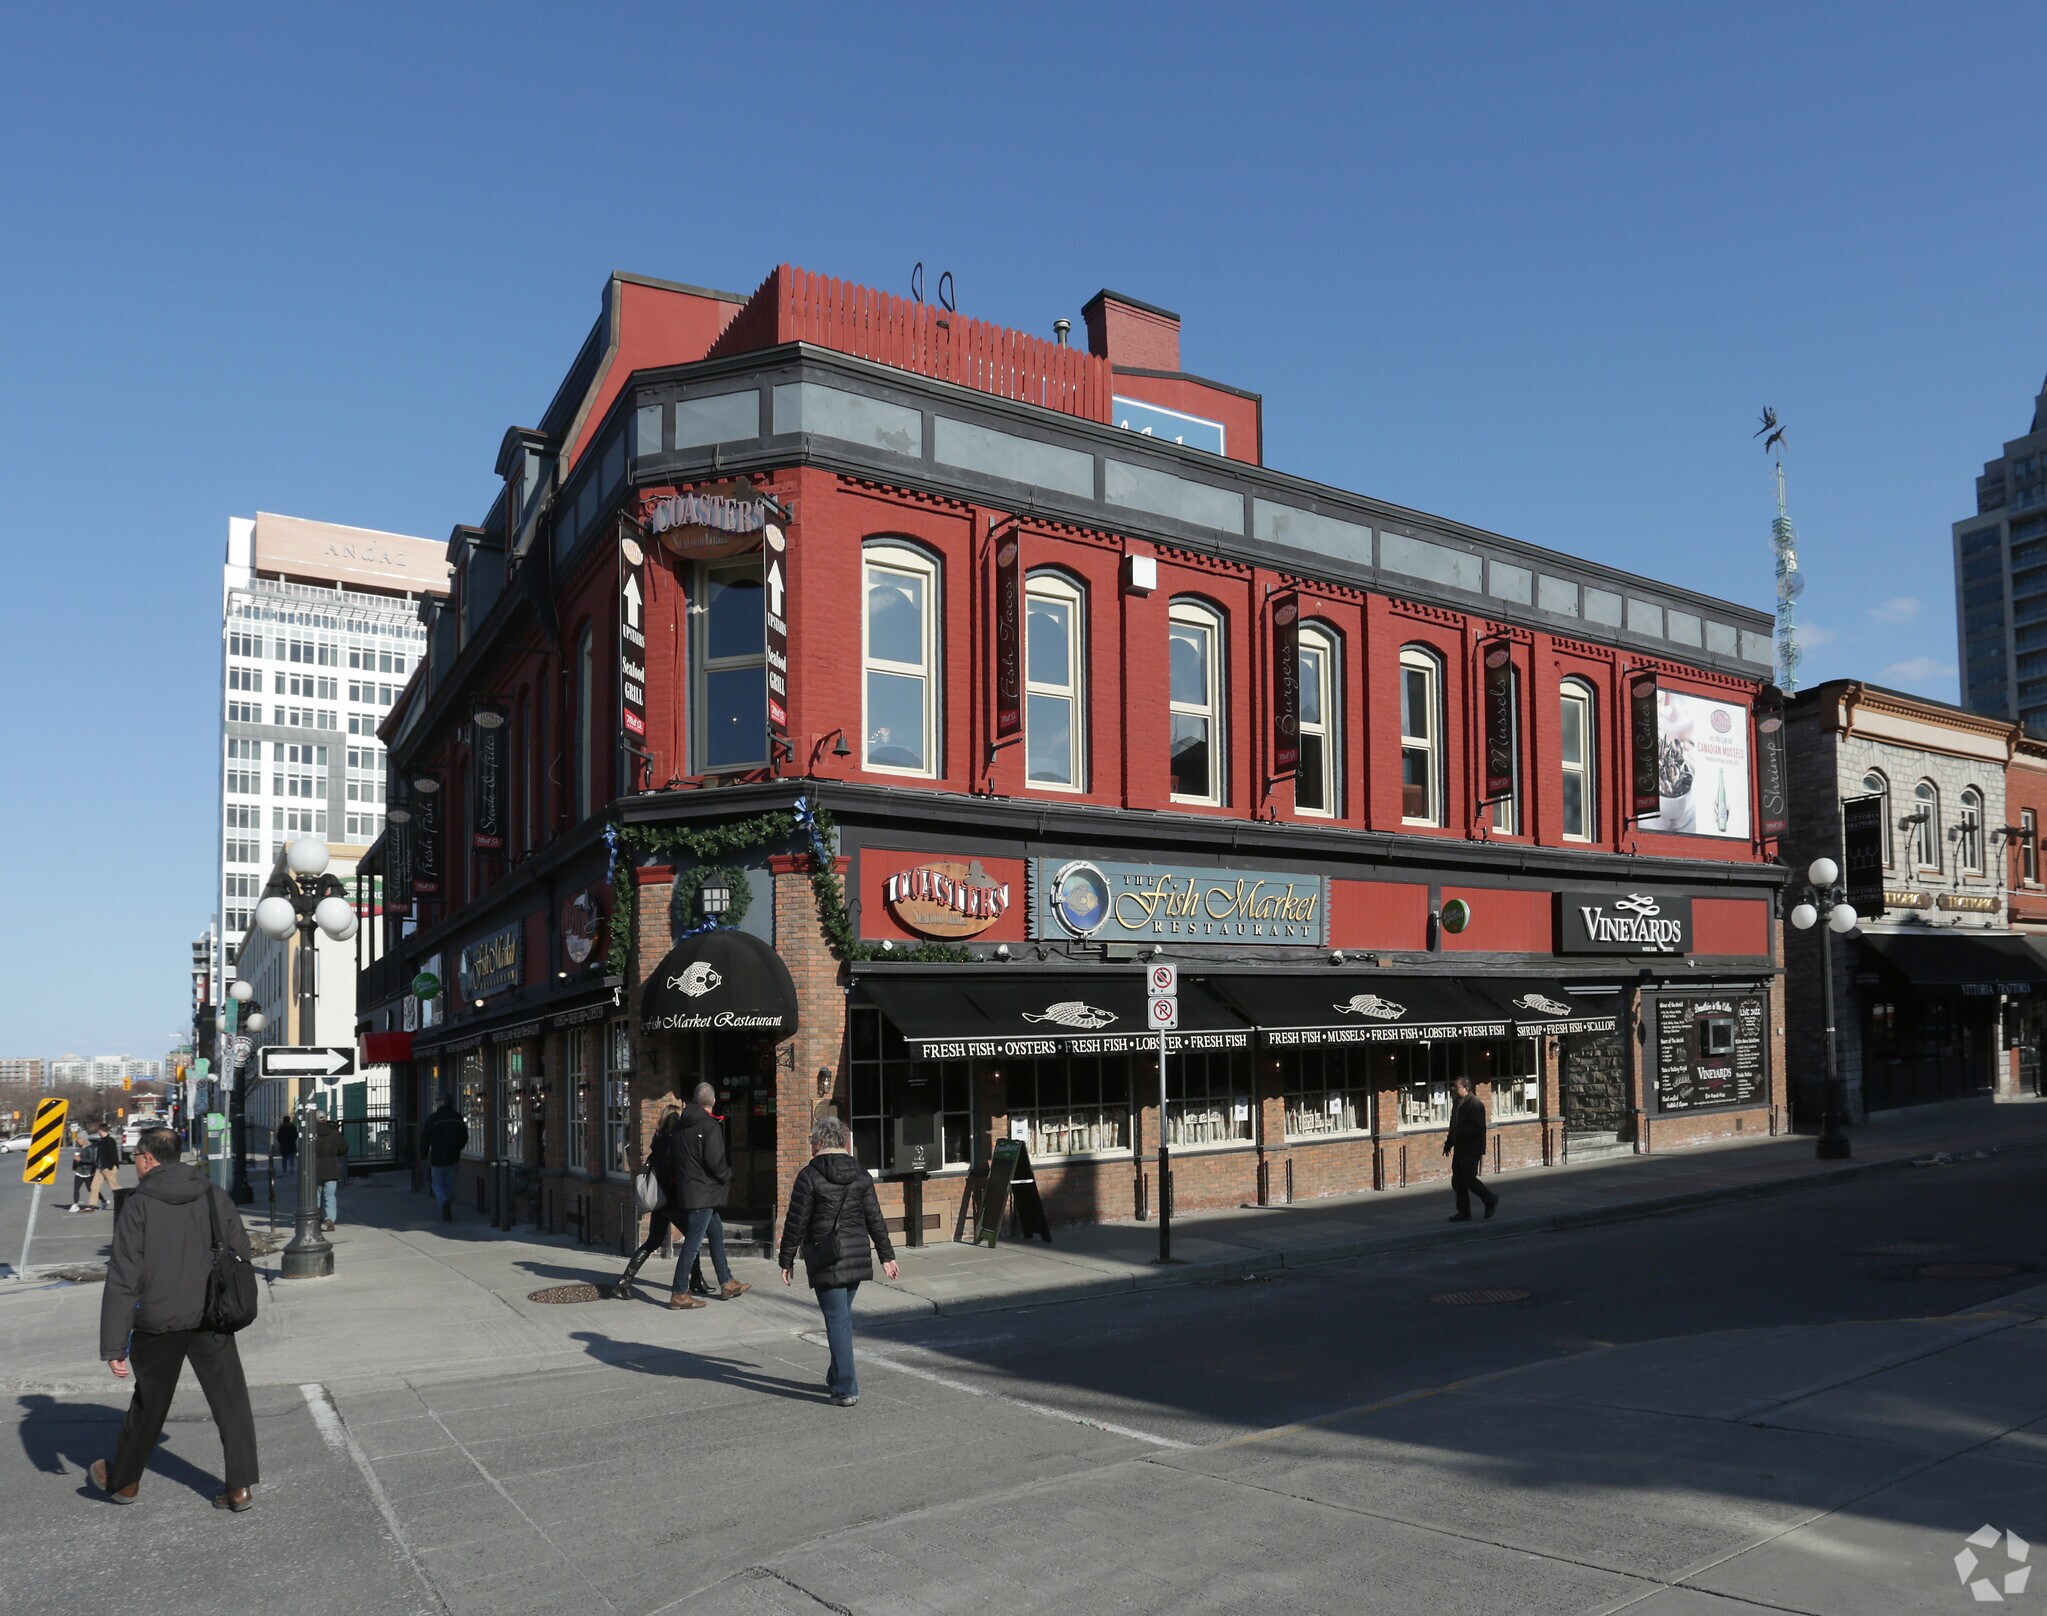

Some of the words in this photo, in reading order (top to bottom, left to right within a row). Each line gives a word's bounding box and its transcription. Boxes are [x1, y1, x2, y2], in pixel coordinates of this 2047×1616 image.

[657, 493, 764, 532] COASTERS
[999, 577, 1015, 642] Tacos
[623, 624, 645, 649] UPSTAIRS
[768, 612, 787, 637] UPSTAIRS
[622, 656, 645, 684] Seafood
[768, 645, 787, 674] Seafood
[770, 671, 786, 697] GRILL
[1000, 648, 1018, 701] Fish
[1275, 640, 1299, 737] Burgers
[624, 681, 644, 706] GRILL
[1489, 679, 1509, 773] Mussels
[1636, 704, 1653, 750] Cakes
[1698, 742, 1722, 755] CANADIAN
[1722, 745, 1744, 759] MUSSELS
[1638, 755, 1656, 792] Crab
[1762, 741, 1784, 815] Shrimp
[883, 866, 1008, 921] COASTERS
[1124, 875, 1156, 886] THE
[1115, 874, 1200, 929] Fish
[1205, 878, 1318, 922] Market
[1152, 920, 1311, 938] RESTAURANT
[1582, 897, 1682, 948] VINEYARDS
[663, 1012, 711, 1029] Market
[713, 1011, 783, 1028] Restaurant
[1517, 1026, 1542, 1037] SHRIMP
[1547, 1023, 1568, 1035] FRESH
[1569, 1022, 1582, 1033] FISH
[1587, 1020, 1616, 1032] SCALLOPS
[923, 1042, 966, 1058] FRESH
[968, 1042, 996, 1056] FISH
[1005, 1040, 1056, 1055] OYSTERS
[1065, 1039, 1099, 1053] FRESH
[1103, 1038, 1127, 1052] FISH
[1191, 1035, 1223, 1048] FRESH
[1225, 1034, 1247, 1047] FISH
[1269, 1032, 1299, 1044] FRESH
[1301, 1031, 1321, 1043] FISH
[1328, 1030, 1365, 1042] MUSSELS
[1371, 1029, 1399, 1041] FRESH
[1400, 1028, 1418, 1039] FISH
[1423, 1026, 1458, 1039] LOBSTER
[1463, 1026, 1488, 1037] FRESH
[1488, 1025, 1505, 1036] FISH
[1697, 1066, 1732, 1080] VINEYARDS
